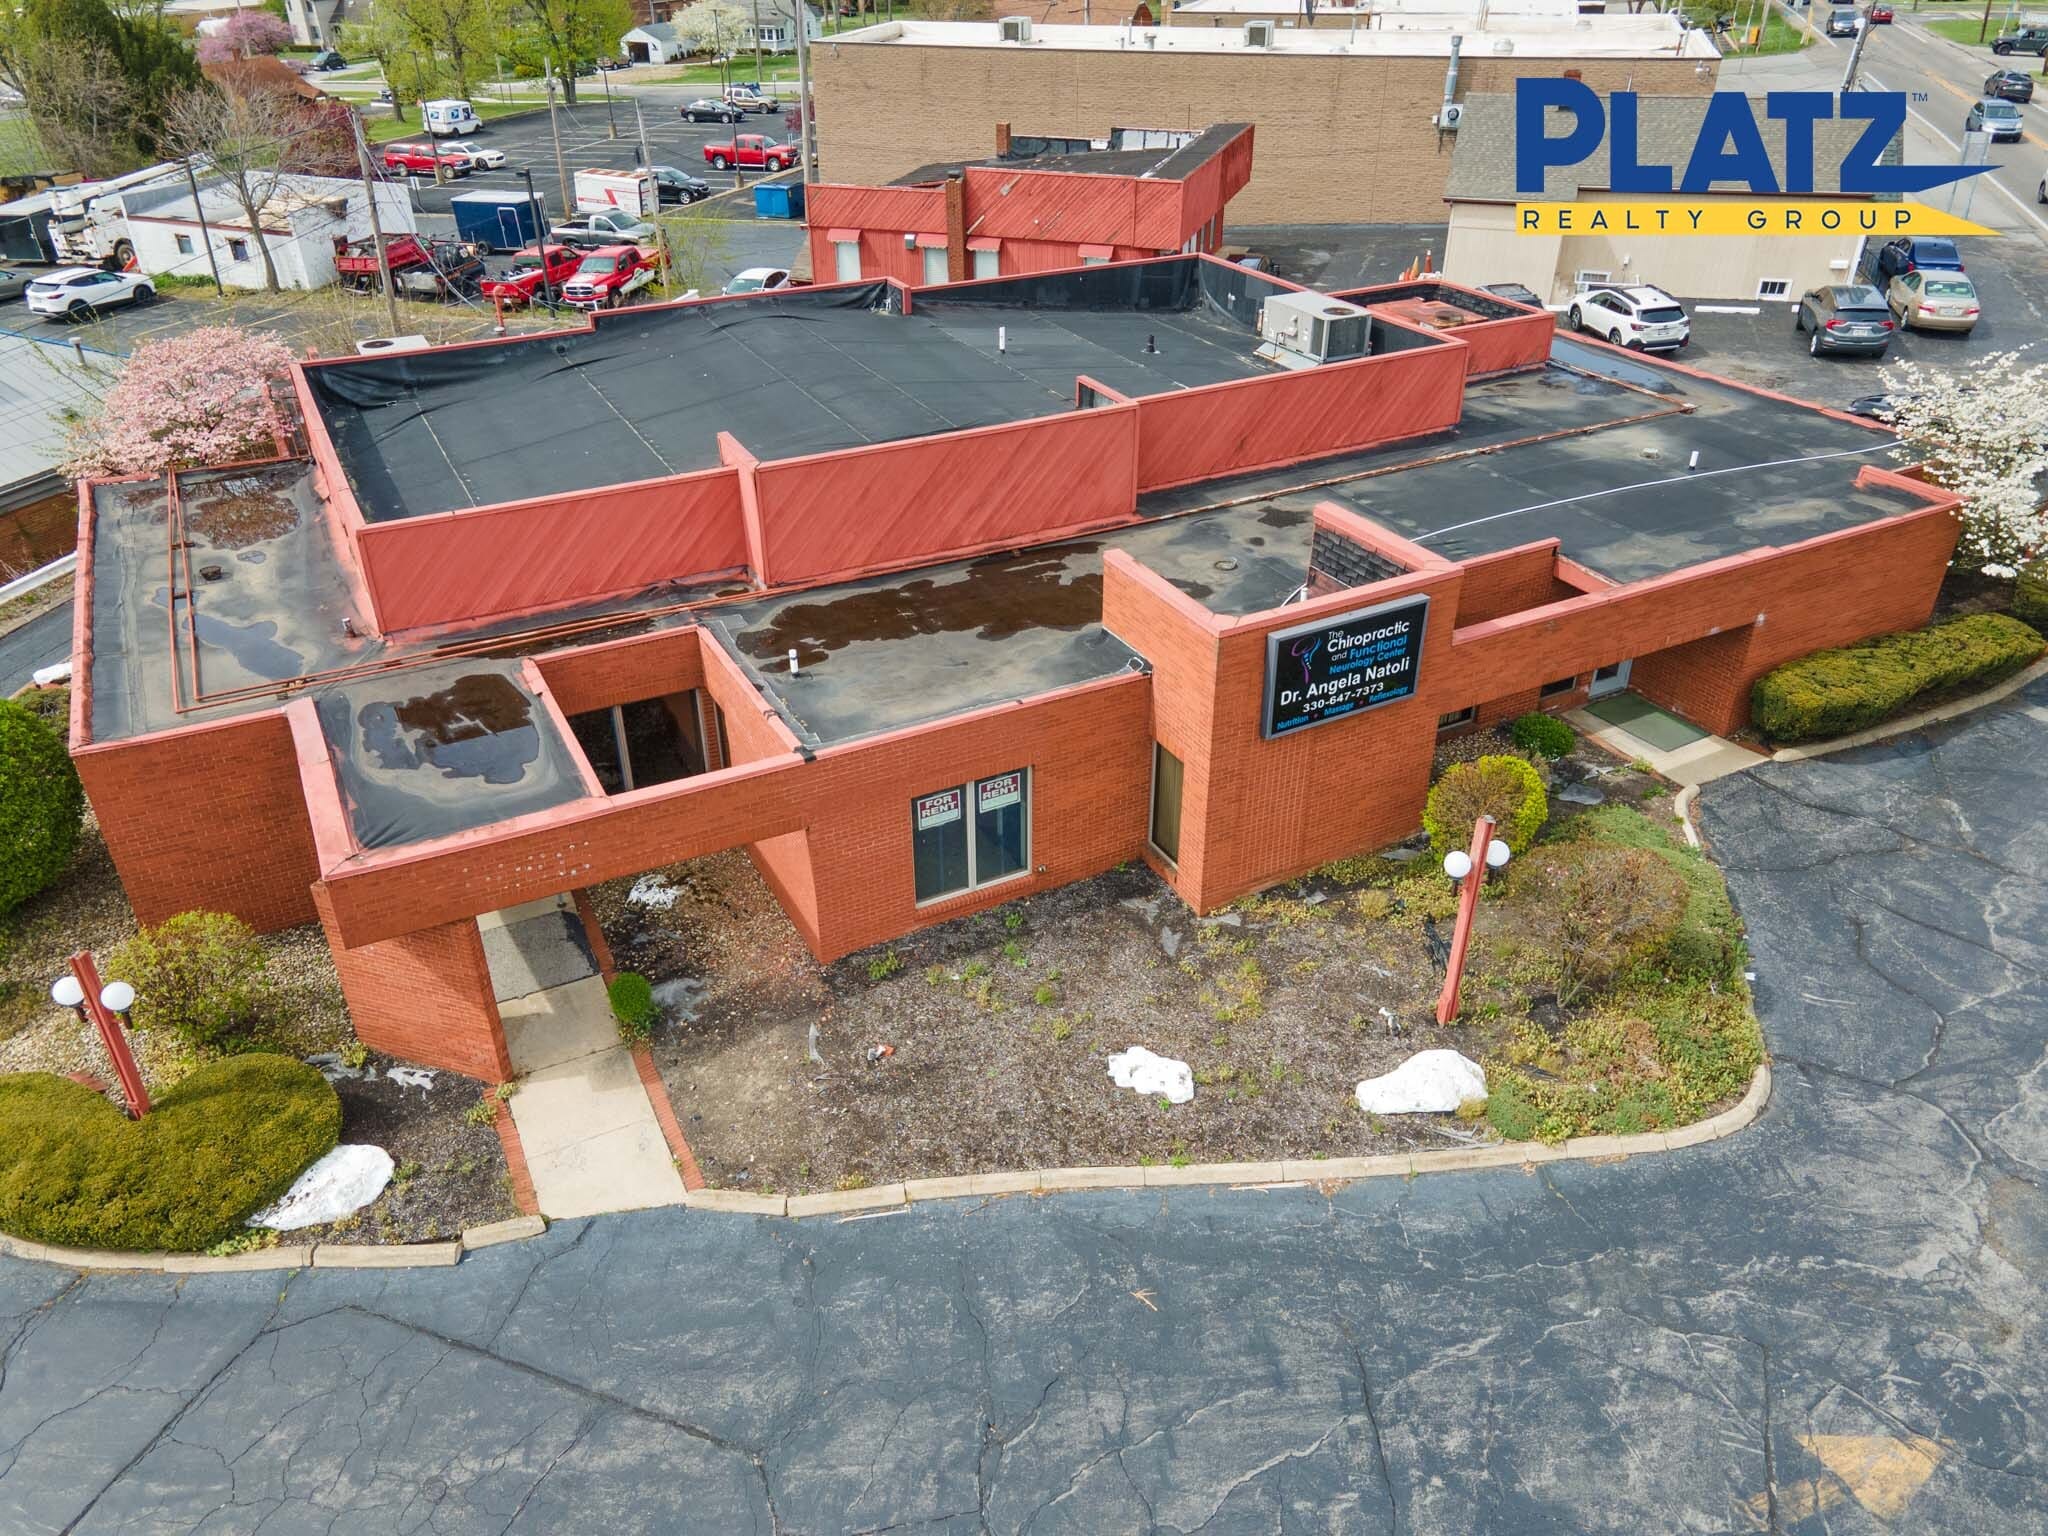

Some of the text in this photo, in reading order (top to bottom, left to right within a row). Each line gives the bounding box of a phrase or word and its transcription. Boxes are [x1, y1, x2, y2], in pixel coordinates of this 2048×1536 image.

[1327, 620, 1410, 652] Chiropractic
[1328, 630, 1344, 640] The
[1331, 635, 1408, 661] and Functional
[1329, 647, 1406, 675] Neurology Center
[1280, 656, 1411, 706] Dr. Angela Natoli
[1302, 682, 1384, 713] 330-647-7373
[1277, 715, 1309, 730] Nutrition
[982, 783, 1017, 800] RENT
[986, 778, 1013, 792] FOR
[921, 801, 957, 818] RENT
[925, 795, 953, 809] FOR
